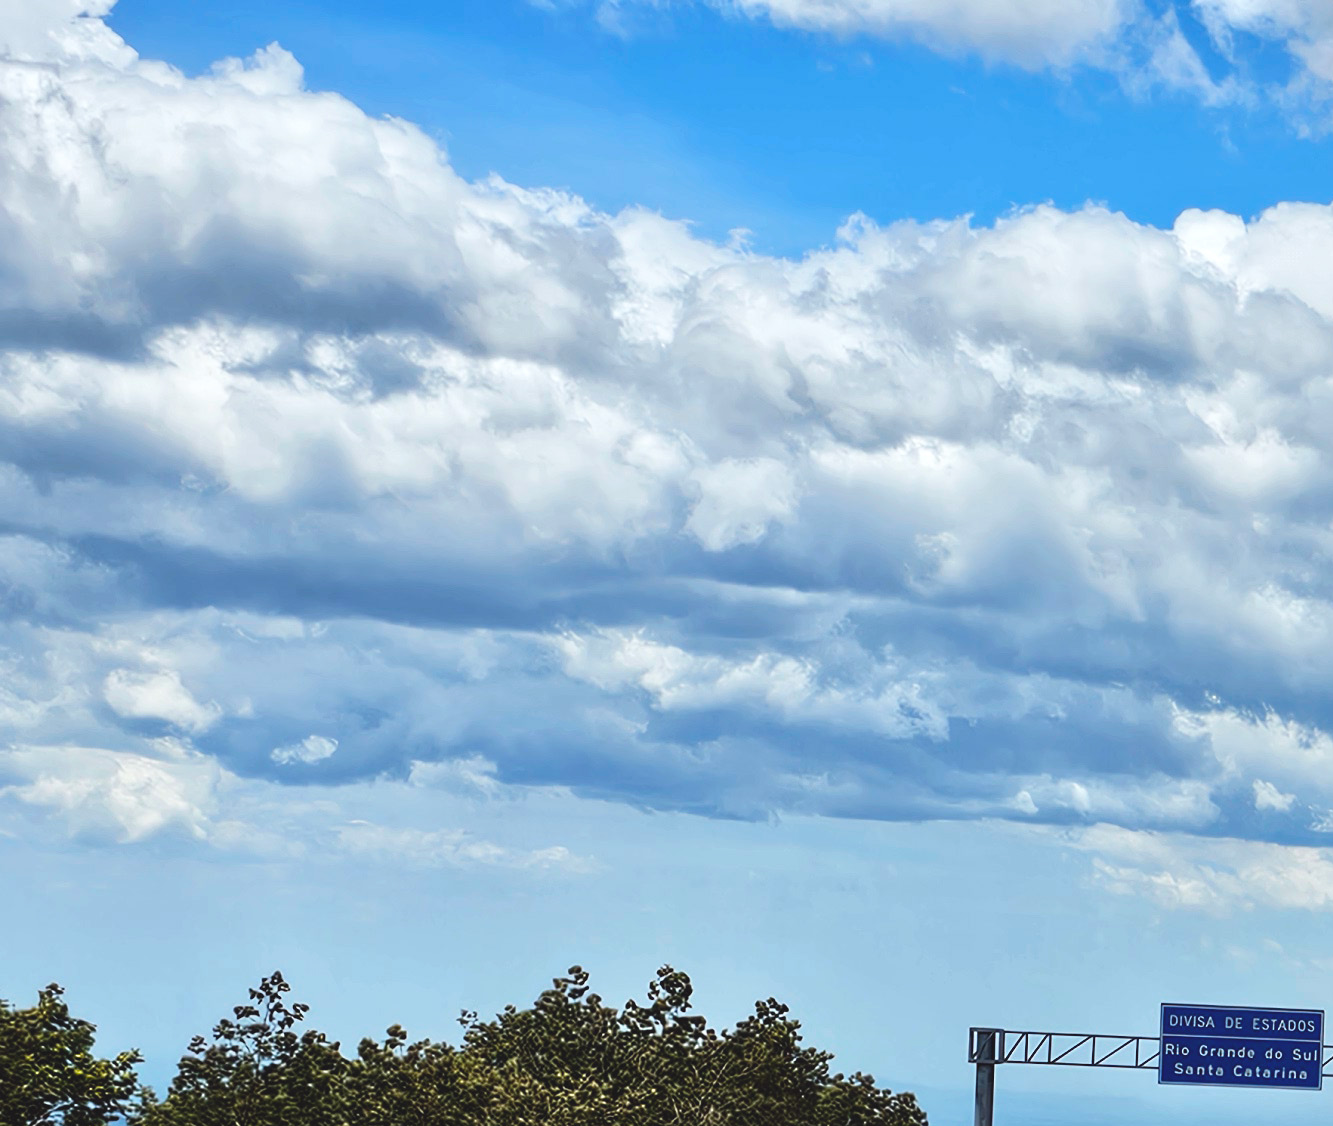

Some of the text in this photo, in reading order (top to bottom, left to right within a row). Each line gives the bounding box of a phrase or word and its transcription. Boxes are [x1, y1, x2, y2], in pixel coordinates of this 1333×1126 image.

[1170, 1015, 1315, 1032] DIVISA DE ESTADOS
[1166, 1044, 1317, 1061] Rio Grande do Sul
[1175, 1063, 1307, 1079] Santa Catarina
